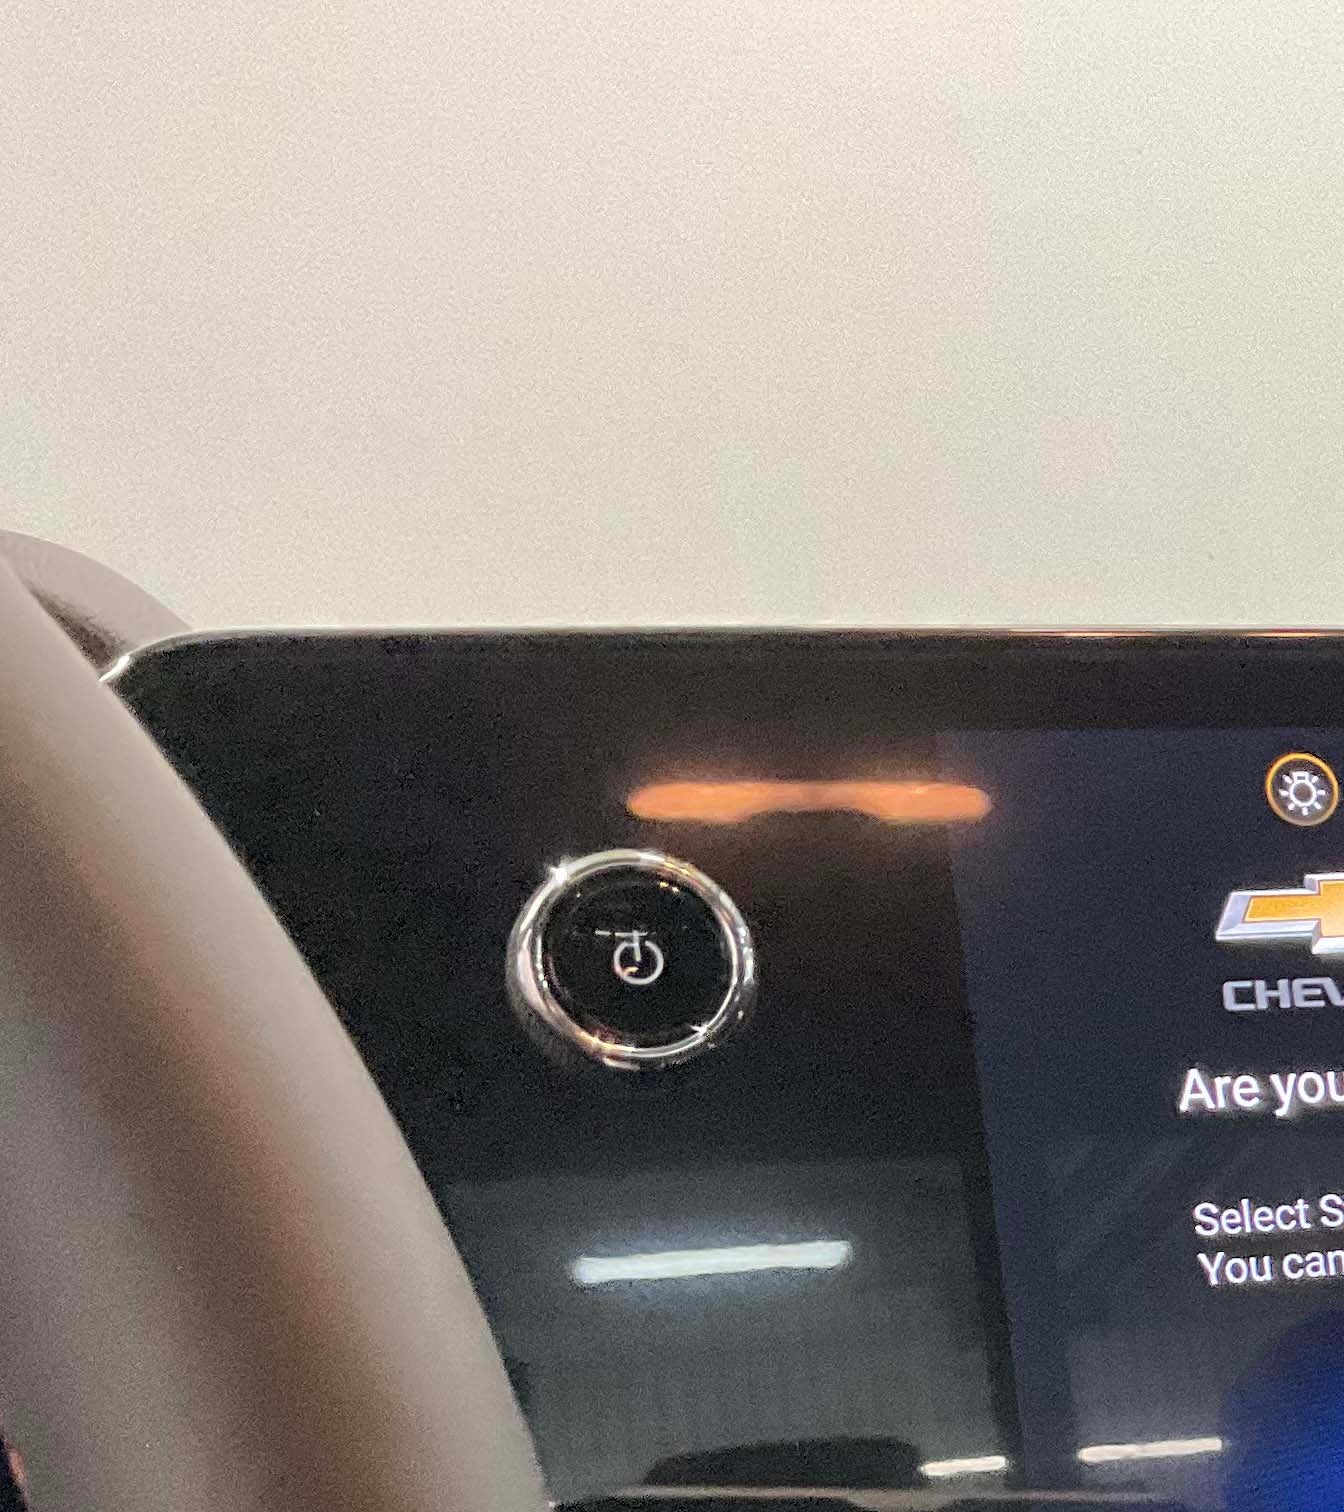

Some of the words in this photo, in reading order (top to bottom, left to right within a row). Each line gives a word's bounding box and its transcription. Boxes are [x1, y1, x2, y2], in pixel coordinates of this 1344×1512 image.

[1178, 1067, 1262, 1112] Are
[1193, 1199, 1310, 1237] Select
[1198, 1251, 1272, 1287] You
